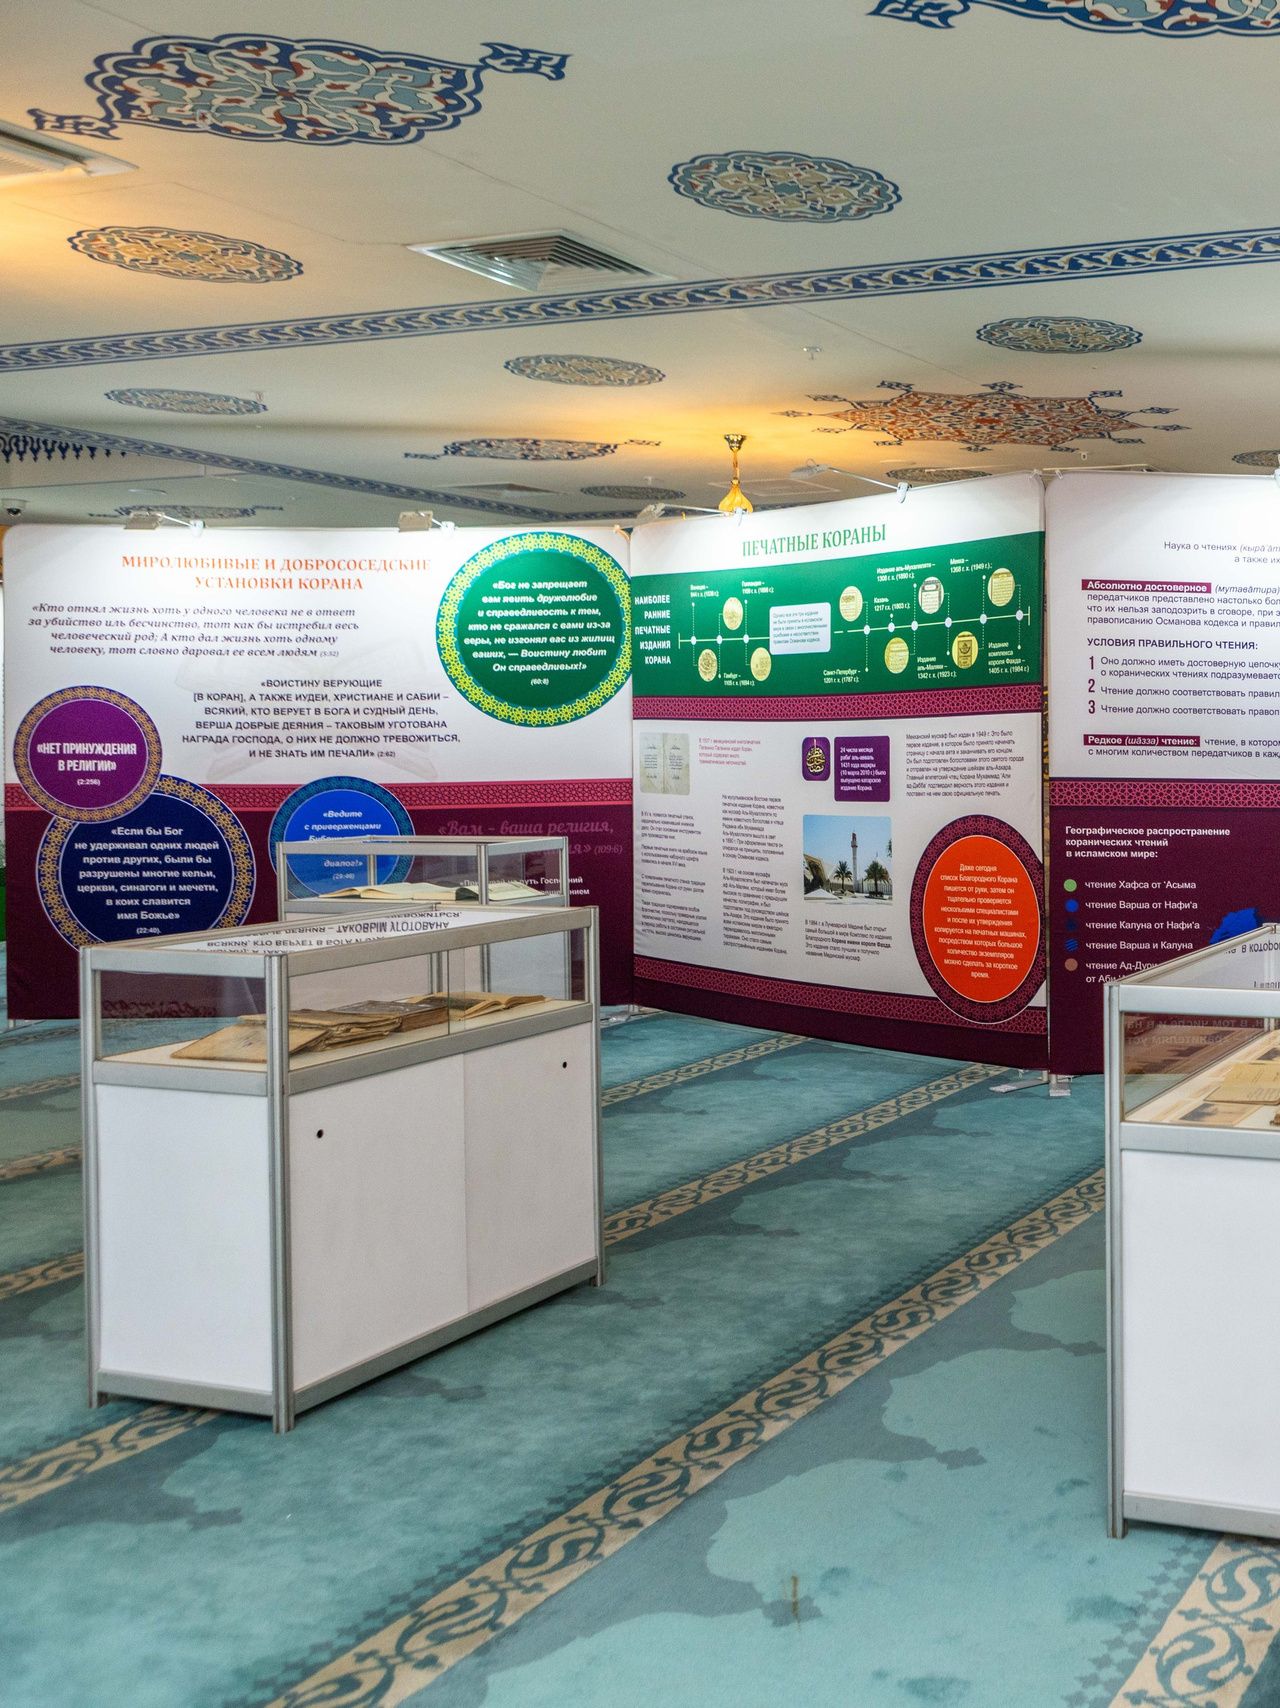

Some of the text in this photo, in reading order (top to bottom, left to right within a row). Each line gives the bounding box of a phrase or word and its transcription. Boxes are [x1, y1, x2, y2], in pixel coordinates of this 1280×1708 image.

[742, 523, 886, 557] ПЕЧАТНЫЕ КОРАНЫ
[121, 555, 432, 573] МИРОЛЮБИВЫЕ И ДОБРОСОСЕДСКИЕ
[195, 576, 363, 590] УСТАНОВКИ КОРАНА
[492, 580, 516, 590] «Бог
[531, 581, 588, 590] запрещает
[1087, 580, 1207, 593] Абсолютно достоверное
[481, 596, 501, 604] вам
[536, 593, 598, 604] дружелюбие
[635, 594, 670, 604] НАИБОЛЕЕ
[32, 603, 65, 613] «Кто
[67, 605, 106, 613] отнял
[108, 606, 150, 614] жизнь
[152, 607, 182, 615] хоть
[182, 608, 191, 617] у
[192, 606, 233, 616] одного
[290, 609, 304, 617] не
[315, 609, 356, 617] ответ
[644, 609, 671, 619] РАННИЕ
[635, 625, 670, 635] ПЕЧАТНЫЕ
[640, 640, 671, 650] ИЗДАНИЯ
[1087, 638, 1258, 650] УСЛОВИЯ ПРАВИЛЬНОГО ЧТЕНИЯ:
[645, 655, 671, 665] КОРАНА
[492, 661, 587, 673] Он справедливых!»
[261, 679, 382, 688] «ВОИСТИНУ ВЕРУЮЩИЕ
[1088, 678, 1095, 693] 2
[1100, 686, 1134, 695] Чтение
[1135, 688, 1170, 696] должно
[1172, 689, 1246, 697] соответствовать
[1088, 735, 1122, 745] Редкое
[37, 742, 137, 756] «НЕТ ПРИНУЖДЕНИЯ
[258, 749, 272, 758] НЕ
[275, 749, 308, 758] ЗНАТЬ
[310, 749, 325, 758] ИМ
[328, 749, 375, 758] ПЕЧАЛИ»
[58, 760, 117, 771] В РЕЛИГИИ»
[323, 810, 363, 818] «Ведите
[111, 826, 184, 836] «Если бы Бог
[311, 823, 382, 832] приверженцами
[1065, 826, 1231, 837] Географическое распространение
[74, 841, 219, 851] не удерживал одних людей
[1065, 838, 1168, 848] коранических чтений
[1074, 850, 1128, 858] исламском
[1130, 851, 1158, 860] мире:
[959, 863, 974, 872] Даже
[959, 874, 997, 883] Благородного
[997, 876, 1018, 884] Корана
[1085, 881, 1117, 889] чтение
[1119, 880, 1149, 891] Хафса
[140, 911, 180, 920] Божье»
[1085, 942, 1118, 950] чтение
[1119, 941, 1150, 951] Варша
[1160, 941, 1193, 952] Калуна
